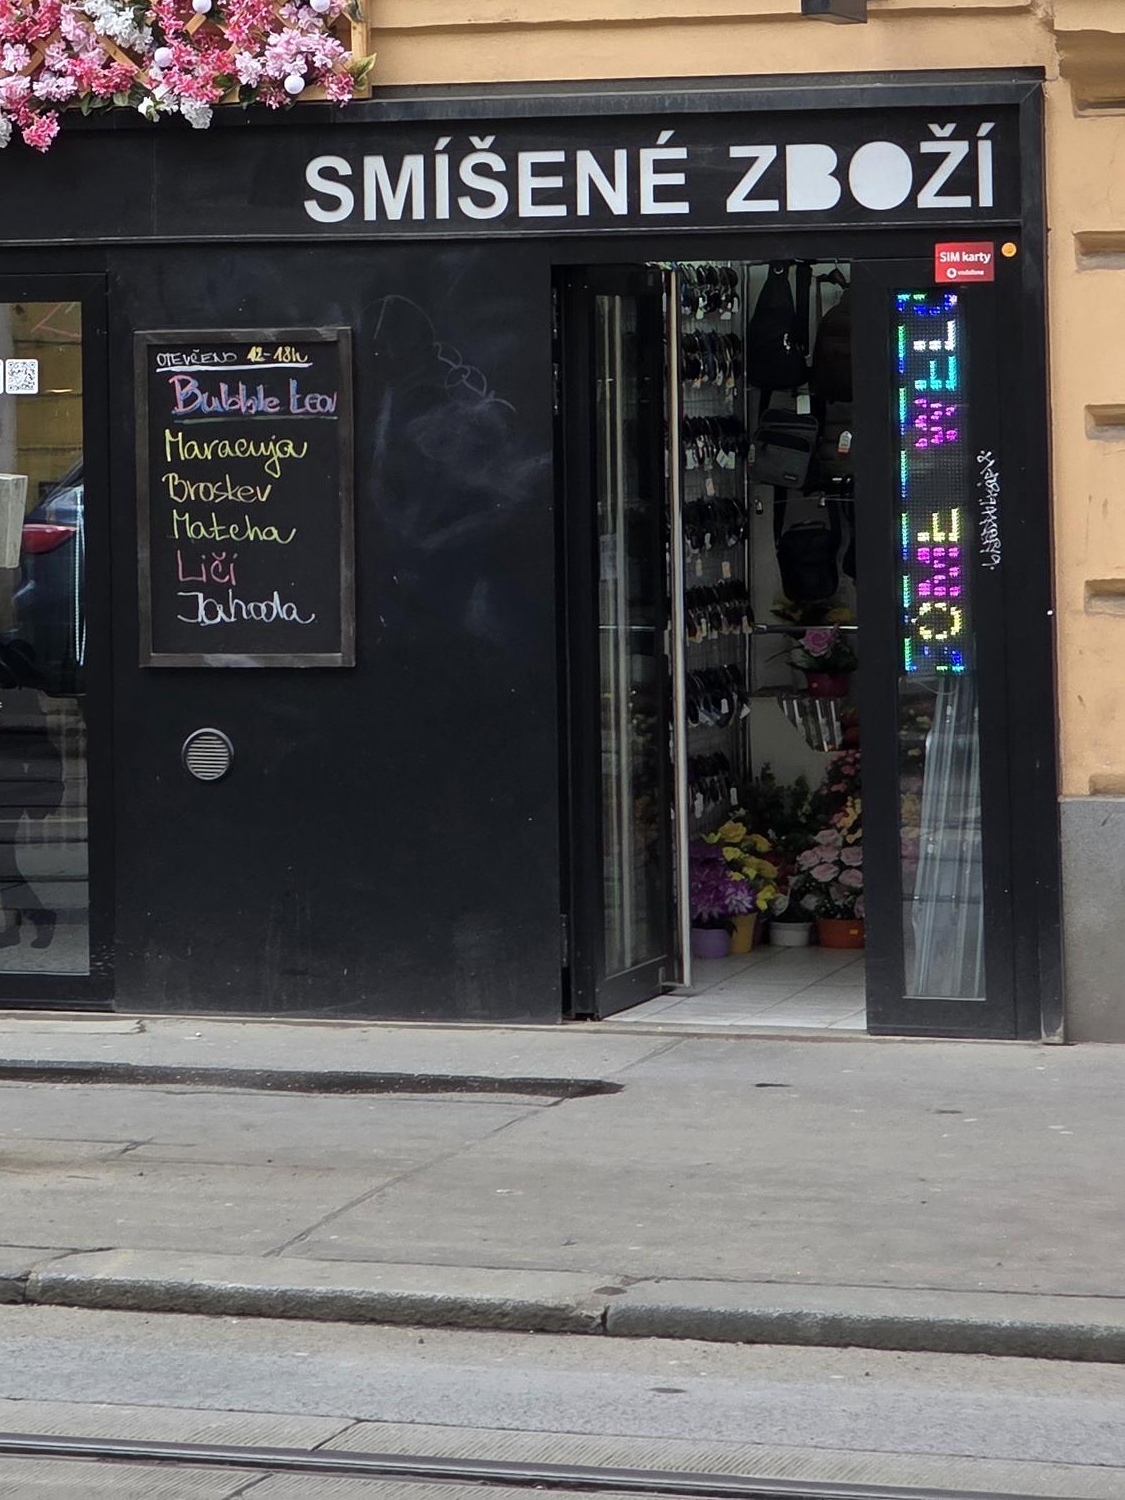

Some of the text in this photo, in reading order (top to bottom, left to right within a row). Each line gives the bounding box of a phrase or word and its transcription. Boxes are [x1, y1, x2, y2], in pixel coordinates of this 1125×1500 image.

[303, 122, 995, 223] SMÍŠENÉ ZBOŽÍ
[939, 251, 991, 264] SIM karty
[168, 374, 280, 415] Bubble
[164, 428, 308, 478] Maracuja
[161, 473, 272, 503] Broskev
[172, 509, 297, 544] Matcha
[177, 588, 316, 626] Jahoda
